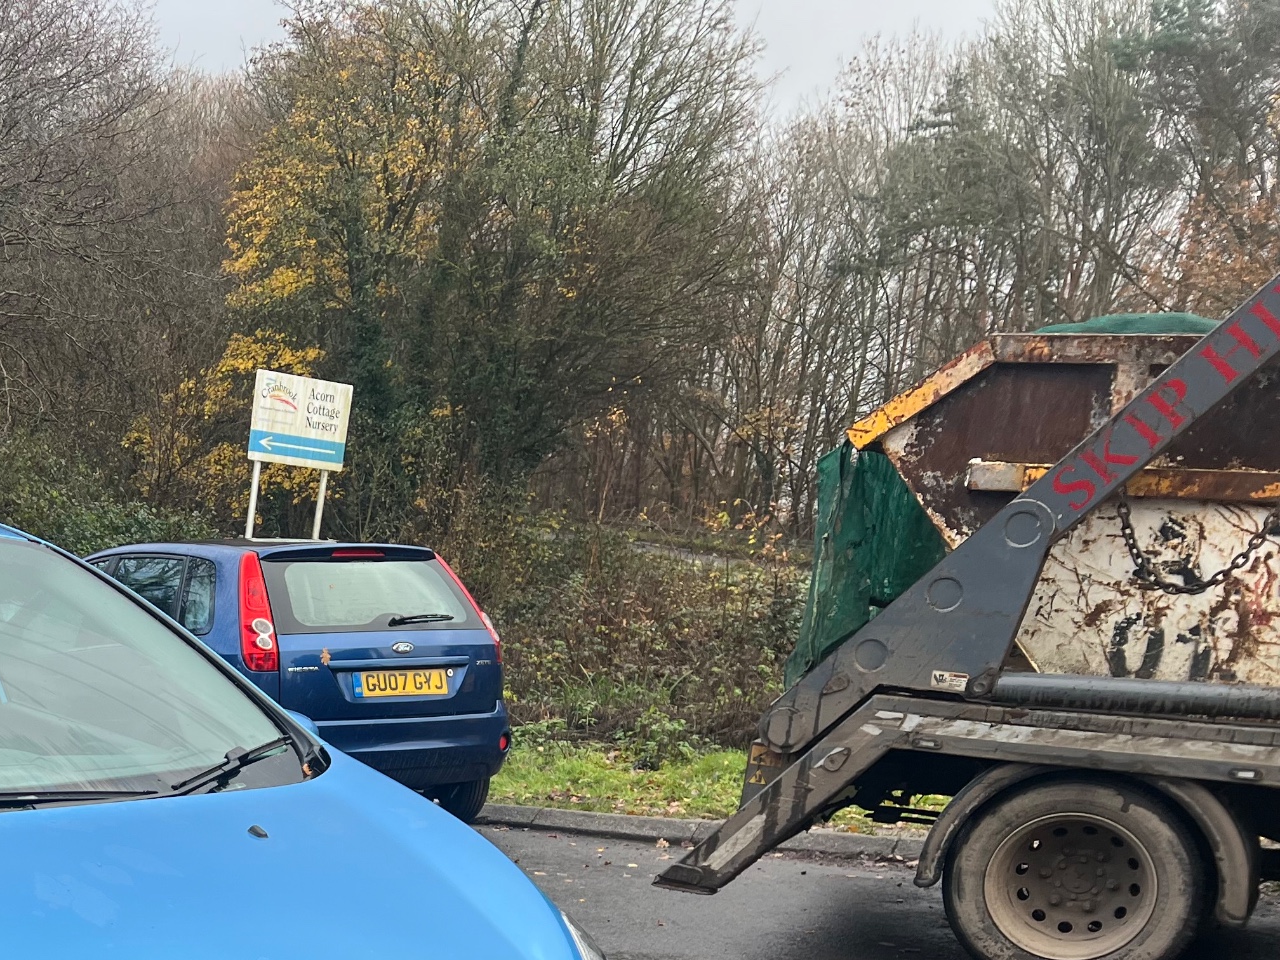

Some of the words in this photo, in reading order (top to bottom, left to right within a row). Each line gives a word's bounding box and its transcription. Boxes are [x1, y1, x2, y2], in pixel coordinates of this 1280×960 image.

[261, 381, 298, 402] Cranbrook
[308, 388, 335, 403] Acorn
[1051, 377, 1188, 512] SKIP
[1196, 284, 1280, 386] HI
[306, 402, 340, 420] Cottage
[304, 416, 338, 434] Nursery
[366, 673, 408, 692] GU07
[413, 672, 444, 690] GYJ
